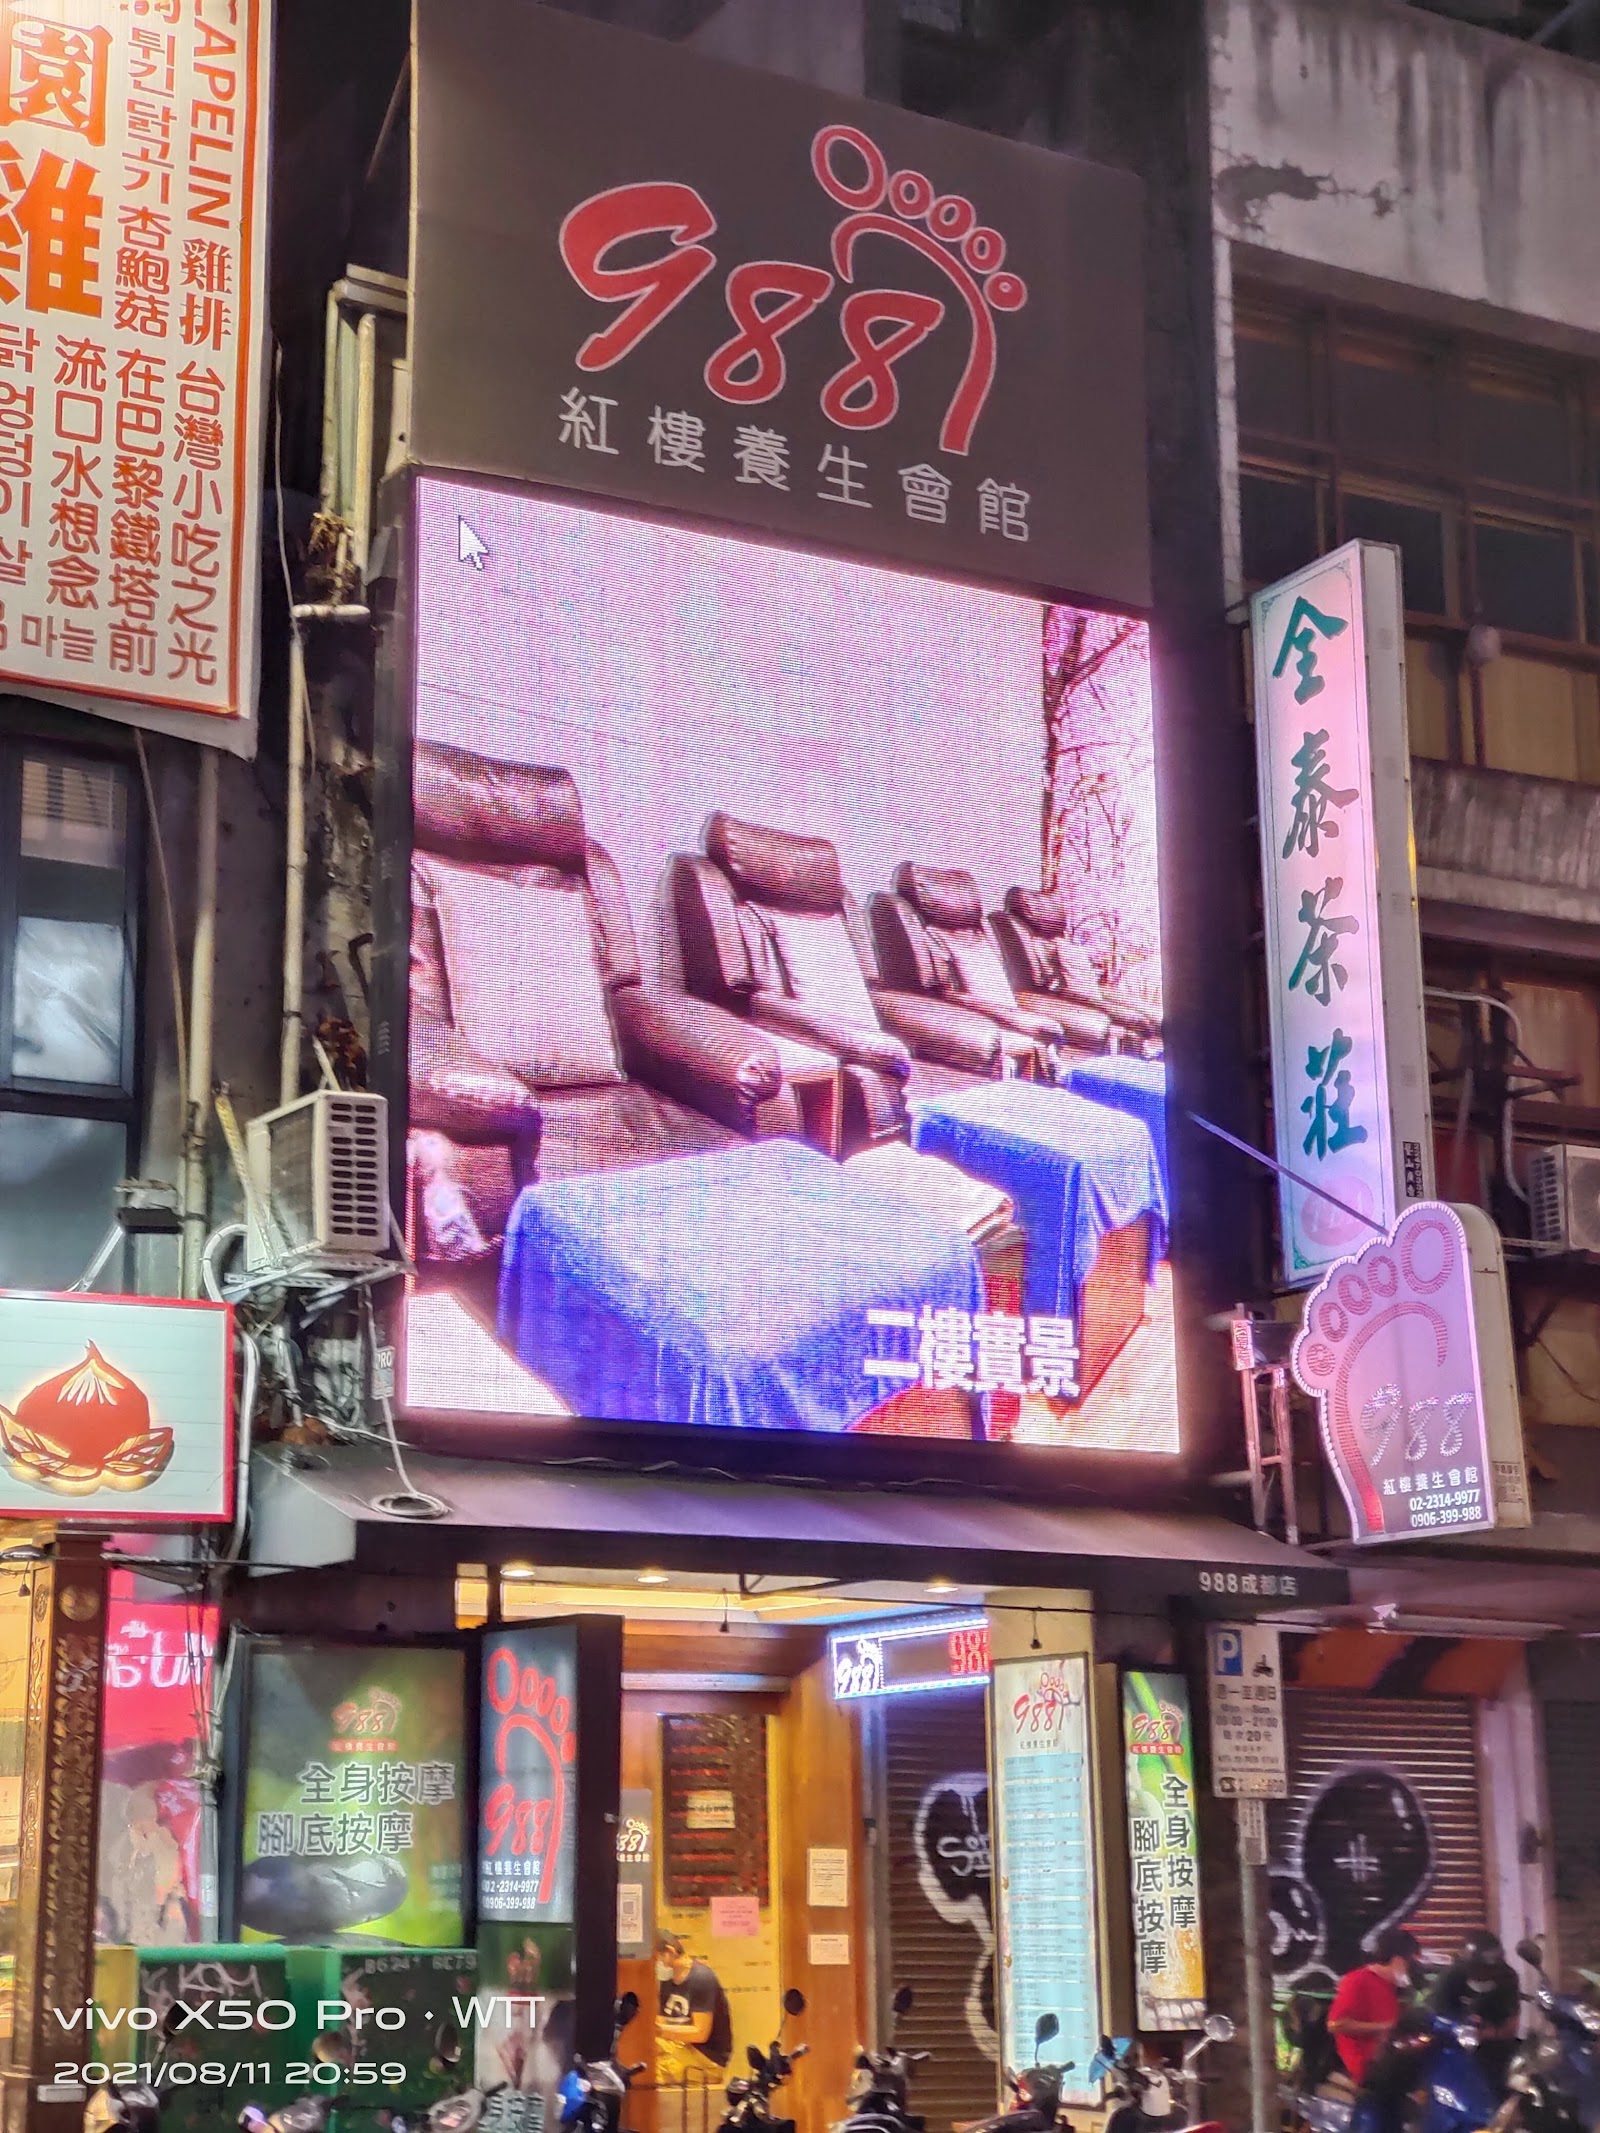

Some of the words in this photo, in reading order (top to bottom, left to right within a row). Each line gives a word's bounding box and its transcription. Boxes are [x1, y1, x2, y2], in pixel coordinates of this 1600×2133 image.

[113, 205, 173, 338] 杏鮑菇
[178, 237, 234, 352] 雞排
[559, 181, 945, 431] 988
[45, 334, 107, 611] 流口水想念
[107, 347, 167, 676] 在巴黎鐵塔前
[558, 387, 1031, 542] 紅樓養生會館
[167, 360, 225, 686] 台灣小吃之光
[863, 1304, 1081, 1397] 二樓實景
[1361, 1383, 1475, 1469] 988
[1382, 1466, 1479, 1496] 紅樓養生會館
[1409, 1488, 1481, 1512] 02-2314-9977
[1411, 1505, 1483, 1528] 0906-399-988
[1217, 1632, 1239, 1672] P
[256, 1812, 414, 1856] 腳底按摩
[300, 1764, 454, 1806] 全身按摩
[485, 1783, 552, 1857] 988
[1133, 1819, 1168, 1975] 腳底按摩
[1162, 1774, 1197, 1929] 全身按摩
